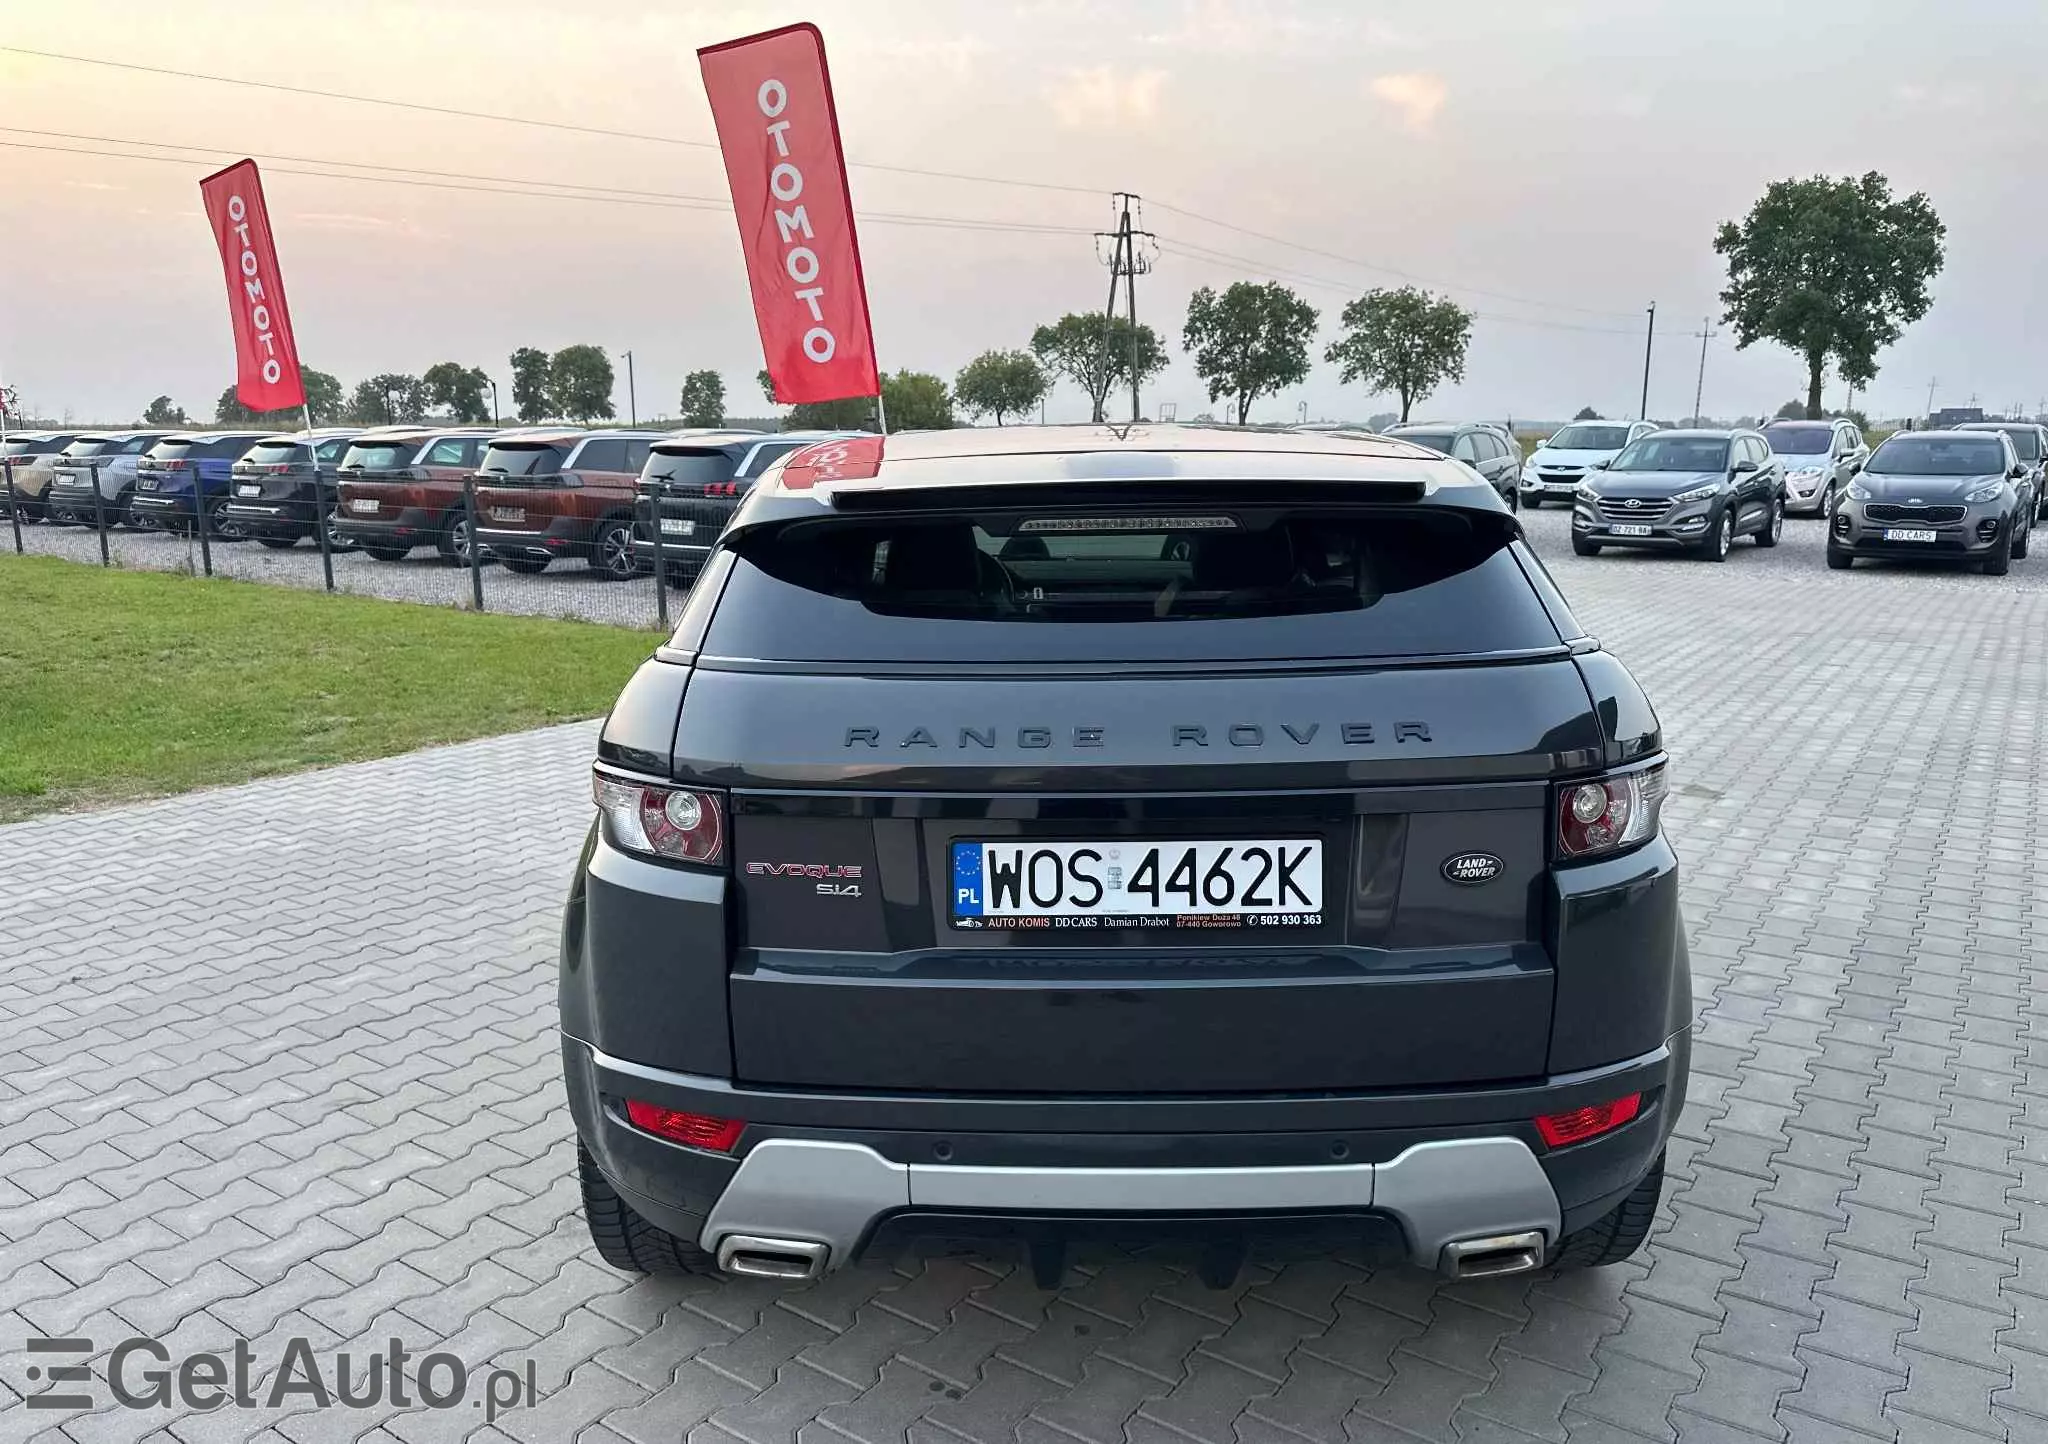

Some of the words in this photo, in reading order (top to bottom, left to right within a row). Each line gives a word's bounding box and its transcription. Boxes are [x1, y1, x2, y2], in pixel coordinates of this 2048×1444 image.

[758, 79, 836, 364] OTOMOTO
[228, 195, 281, 385] OTOMOTO
[1891, 530, 1904, 539] DD
[1906, 531, 1932, 540] CARS
[843, 726, 1105, 749] RANGE
[1170, 721, 1433, 748] ROVER
[745, 862, 862, 879] EVOQUE
[987, 848, 1104, 909] WOS
[1127, 846, 1314, 908] 4462K
[1459, 867, 1496, 878] ROVER
[816, 884, 862, 898] Si4
[957, 887, 980, 905] PL
[988, 917, 1016, 928] AUTO
[1018, 917, 1050, 928] KOMIS
[1104, 916, 1138, 927] Damian
[1140, 916, 1170, 927] Drabot
[1260, 915, 1279, 925] 502
[1282, 915, 1300, 925] 930
[1303, 914, 1322, 924] 363
